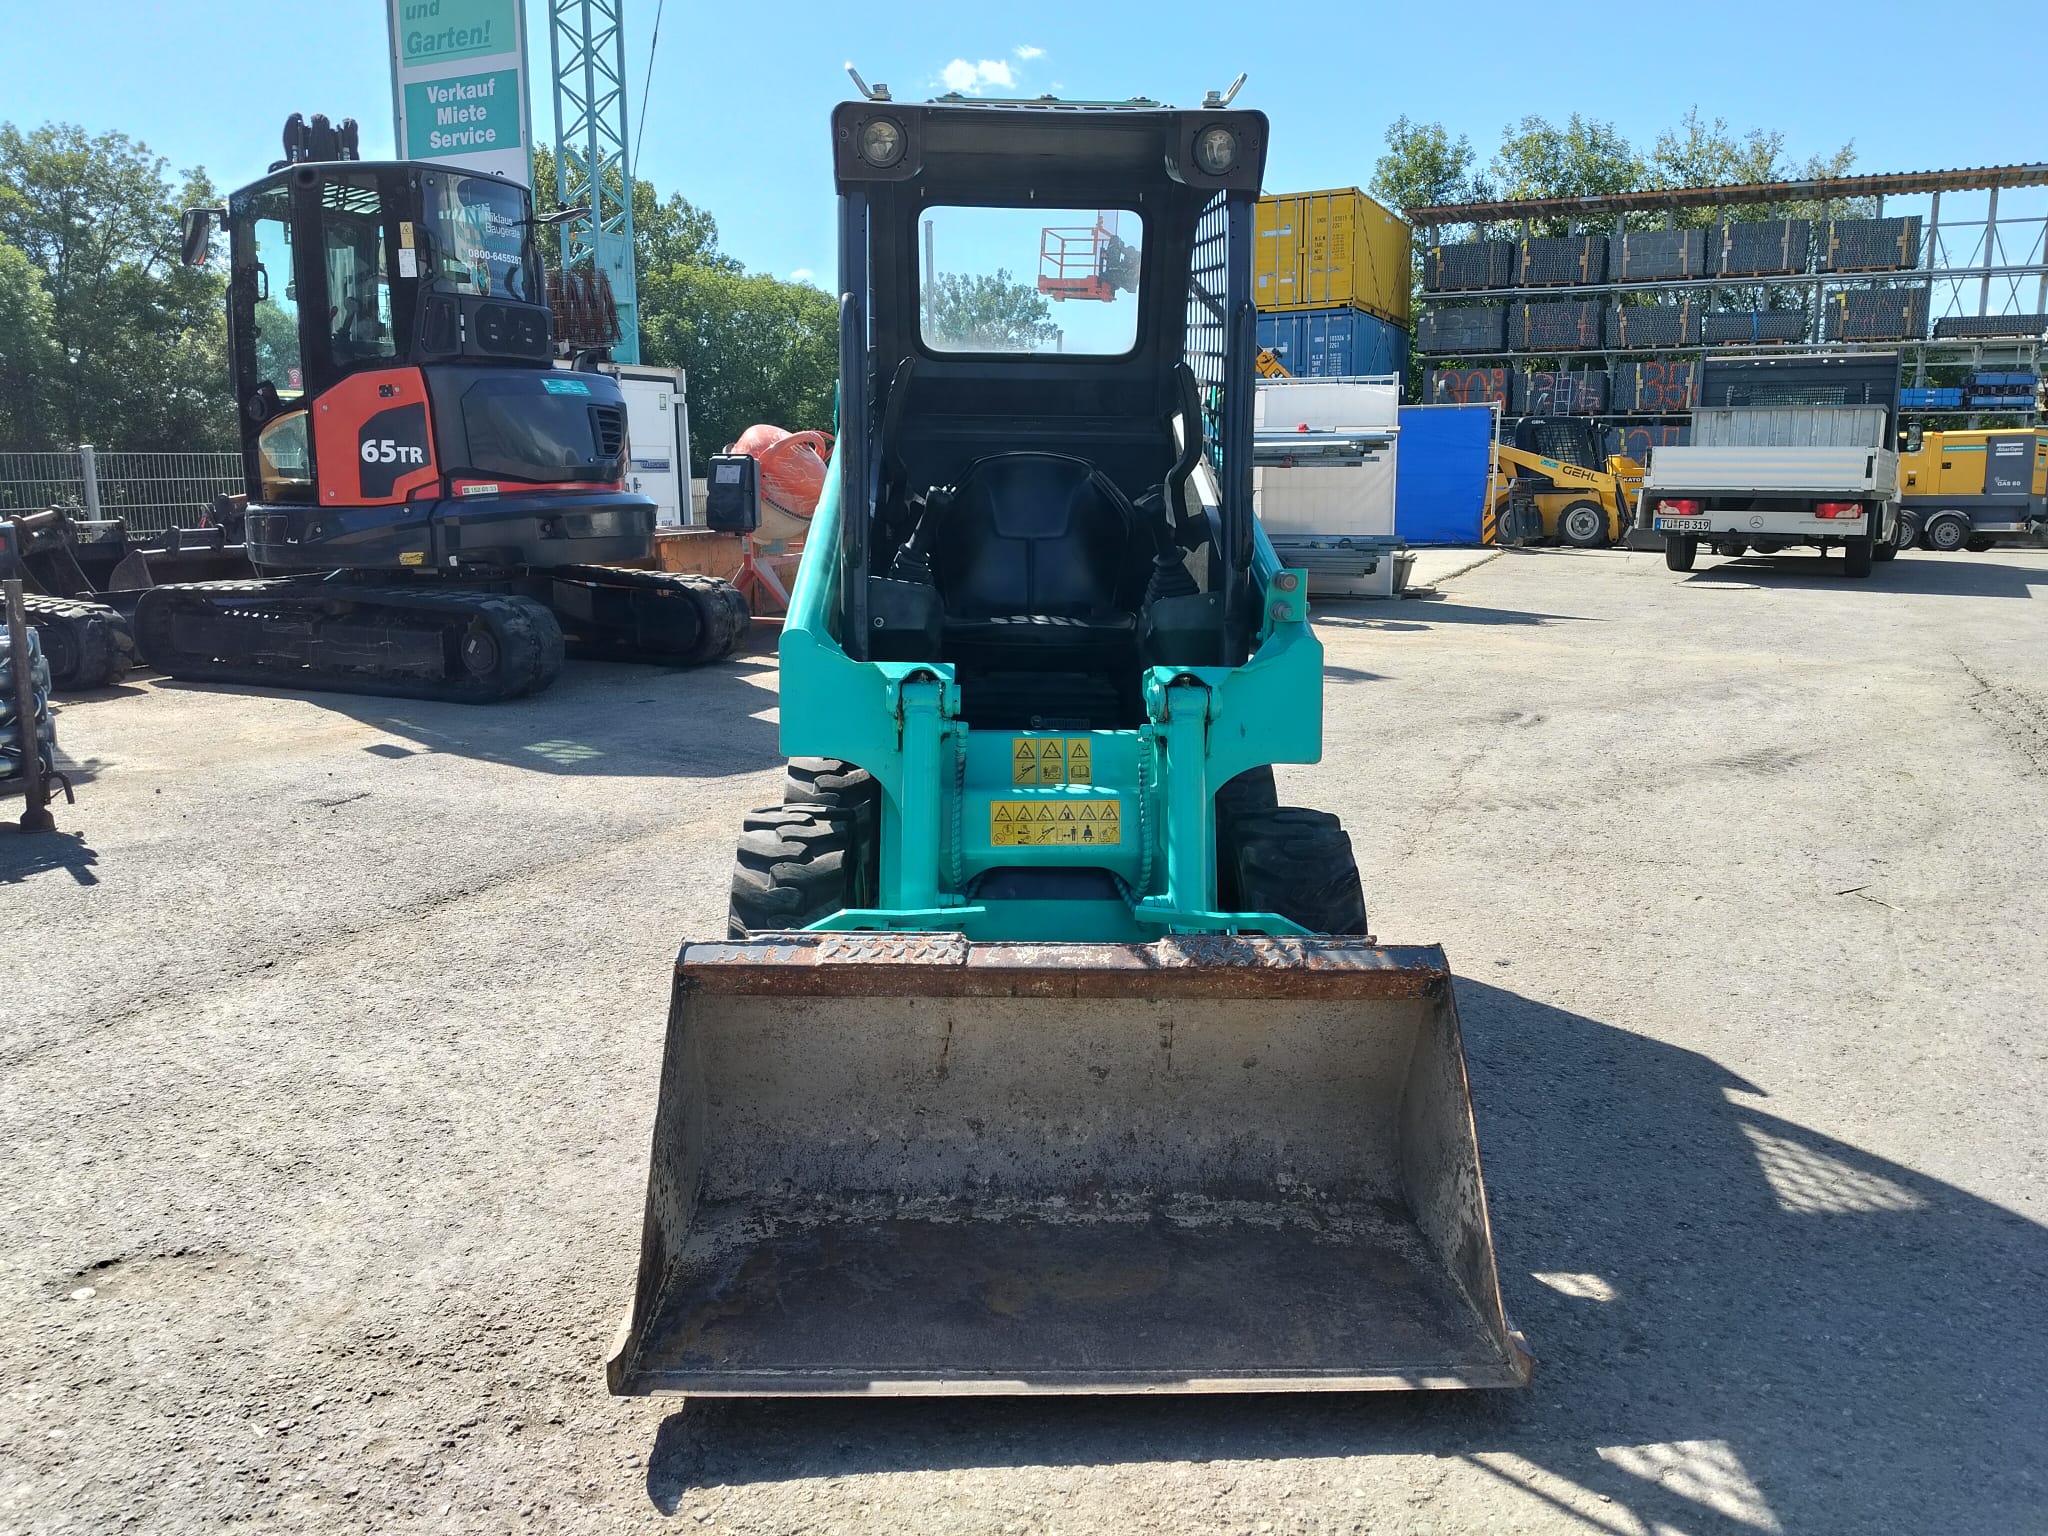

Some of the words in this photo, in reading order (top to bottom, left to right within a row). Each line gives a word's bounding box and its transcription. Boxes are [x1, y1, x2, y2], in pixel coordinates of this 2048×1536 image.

[406, 0, 440, 20] und
[406, 20, 491, 55] Garten!
[427, 78, 496, 104] Verkauf
[437, 104, 487, 126] Miete
[430, 126, 497, 149] Service
[485, 211, 513, 226] Niklaus
[468, 248, 522, 265] 0800-6455287
[361, 439, 424, 464] 65TR
[1562, 465, 1599, 483] GEHL
[1678, 520, 1690, 530] FB
[1691, 520, 1709, 530] 319
